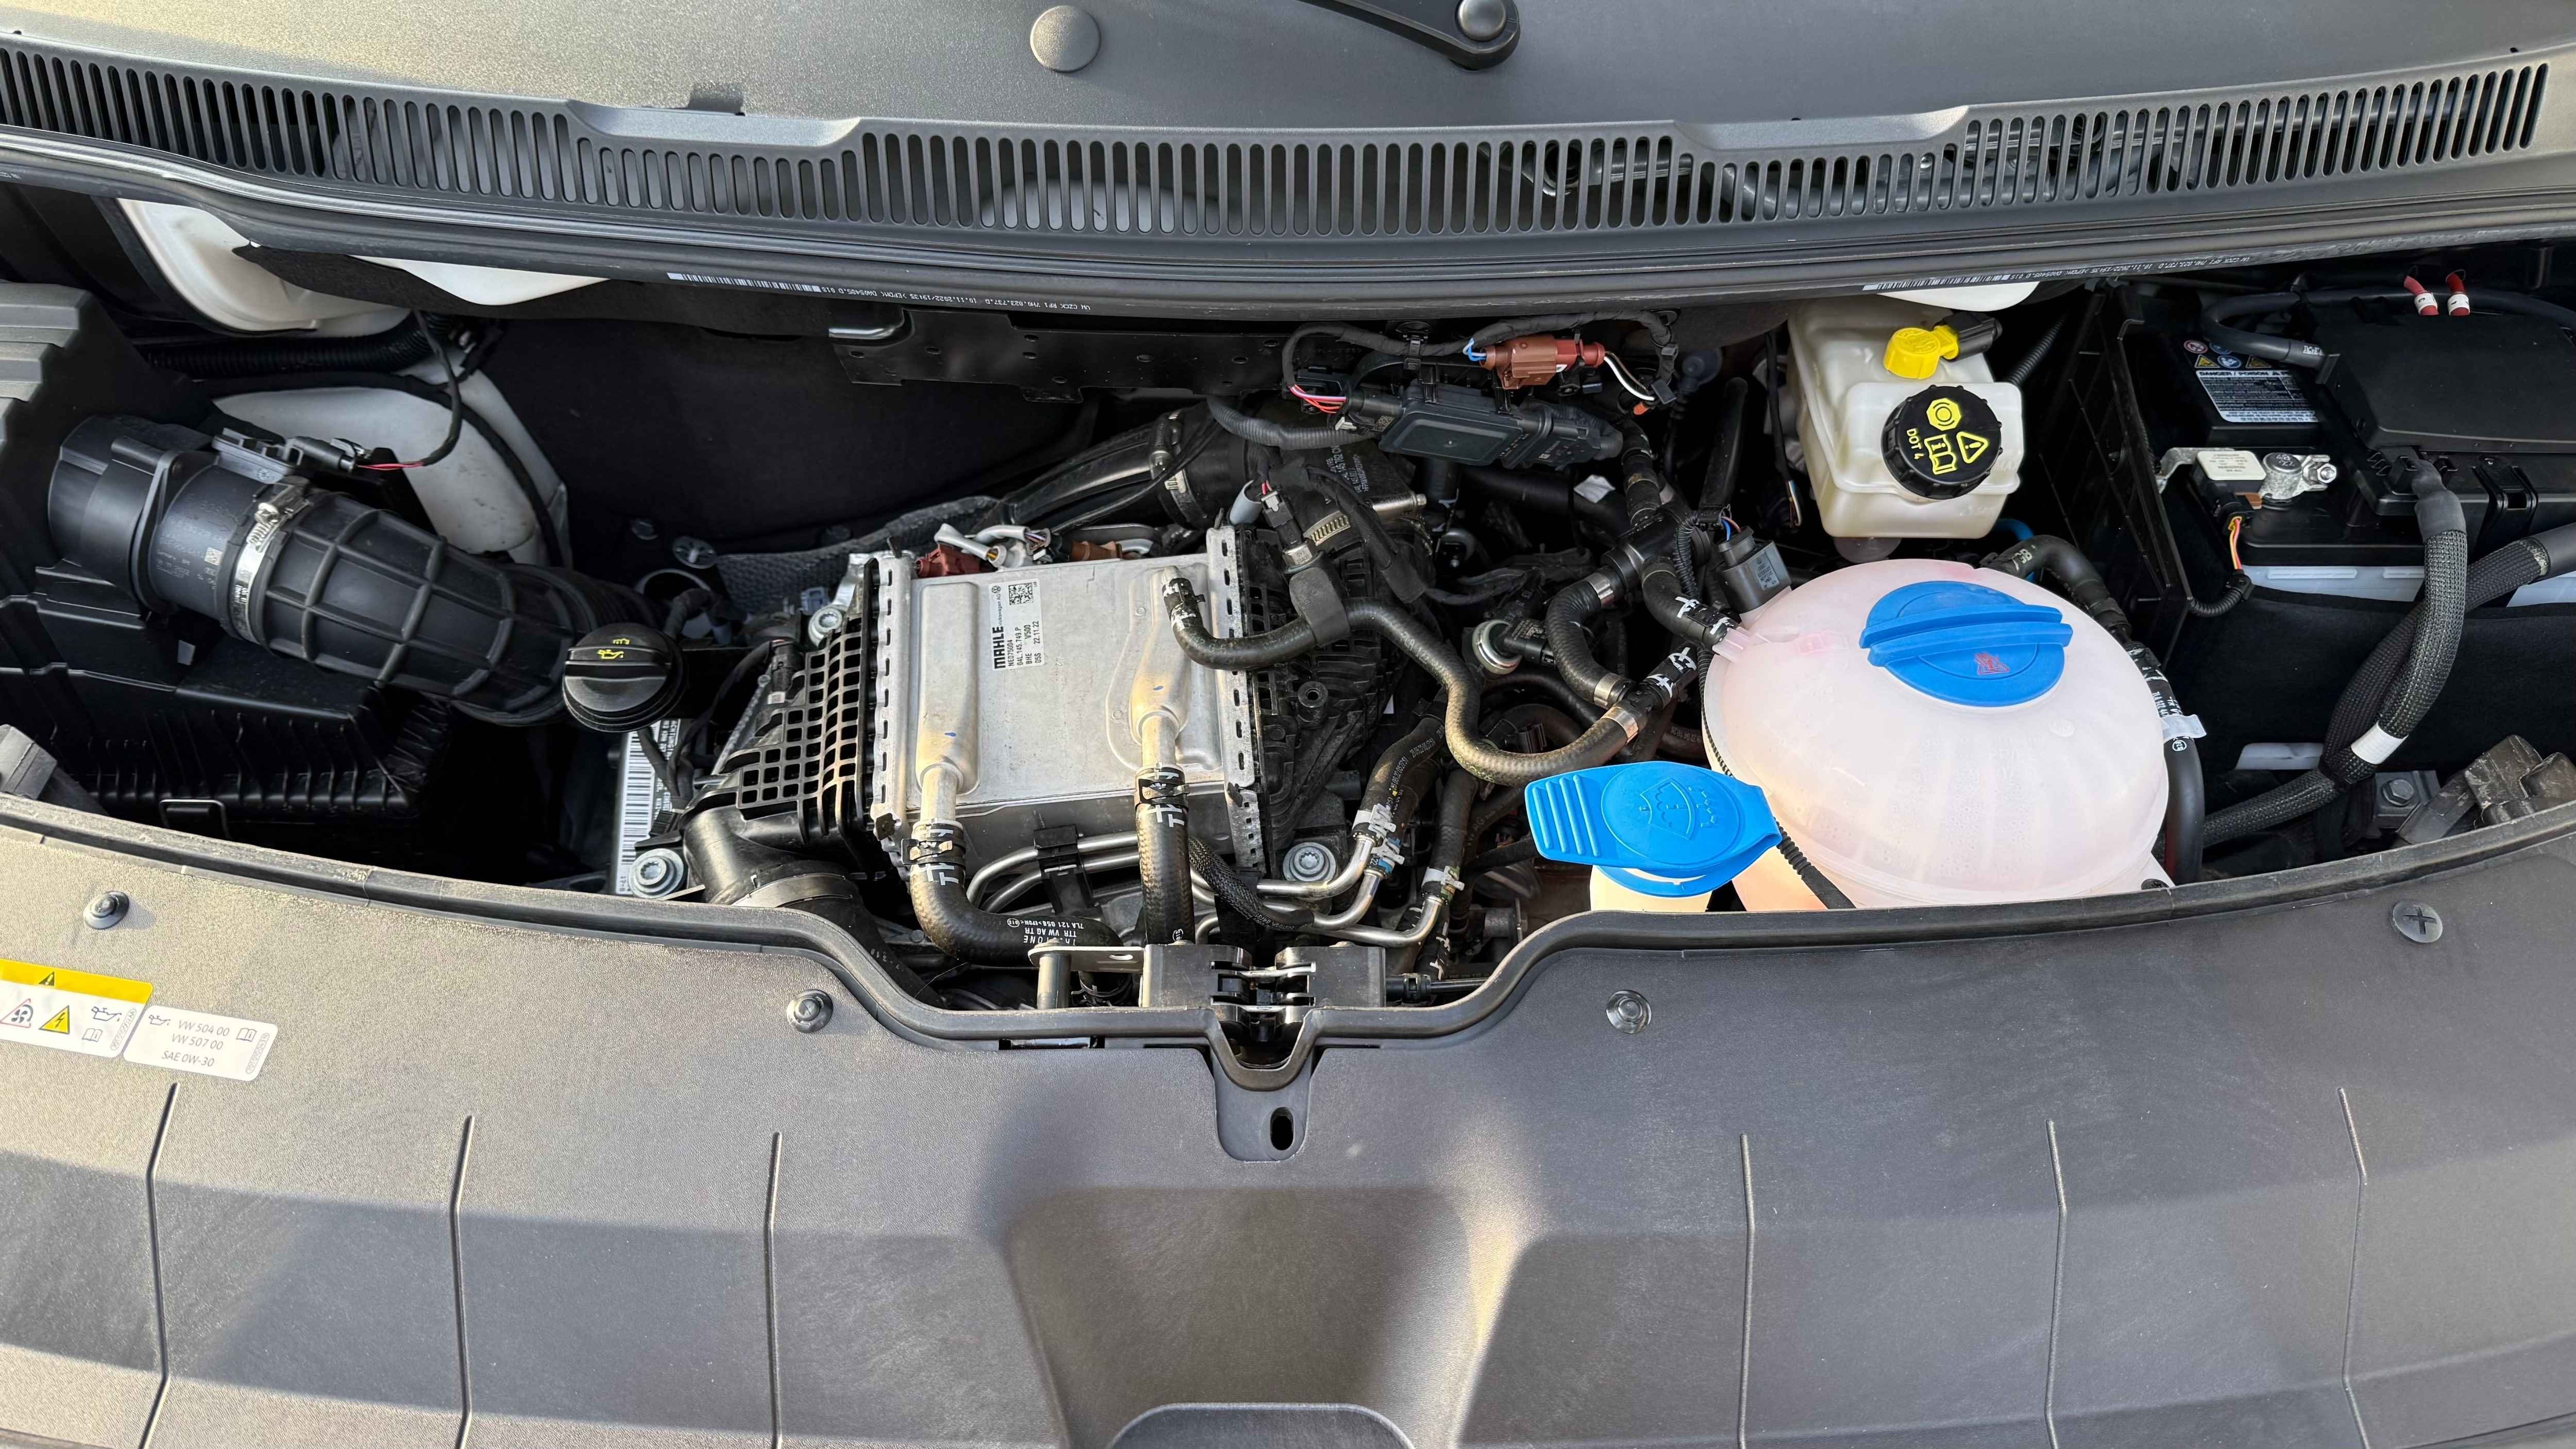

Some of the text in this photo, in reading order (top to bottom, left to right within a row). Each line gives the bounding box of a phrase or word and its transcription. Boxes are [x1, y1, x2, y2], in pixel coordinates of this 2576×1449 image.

[1907, 428, 1922, 449] DOT
[992, 626, 1006, 669] MAHLE
[179, 1020, 230, 1037] VW 504 00
[172, 1033, 224, 1050] VW 507 00
[161, 1051, 215, 1067] SAE 0W-30
